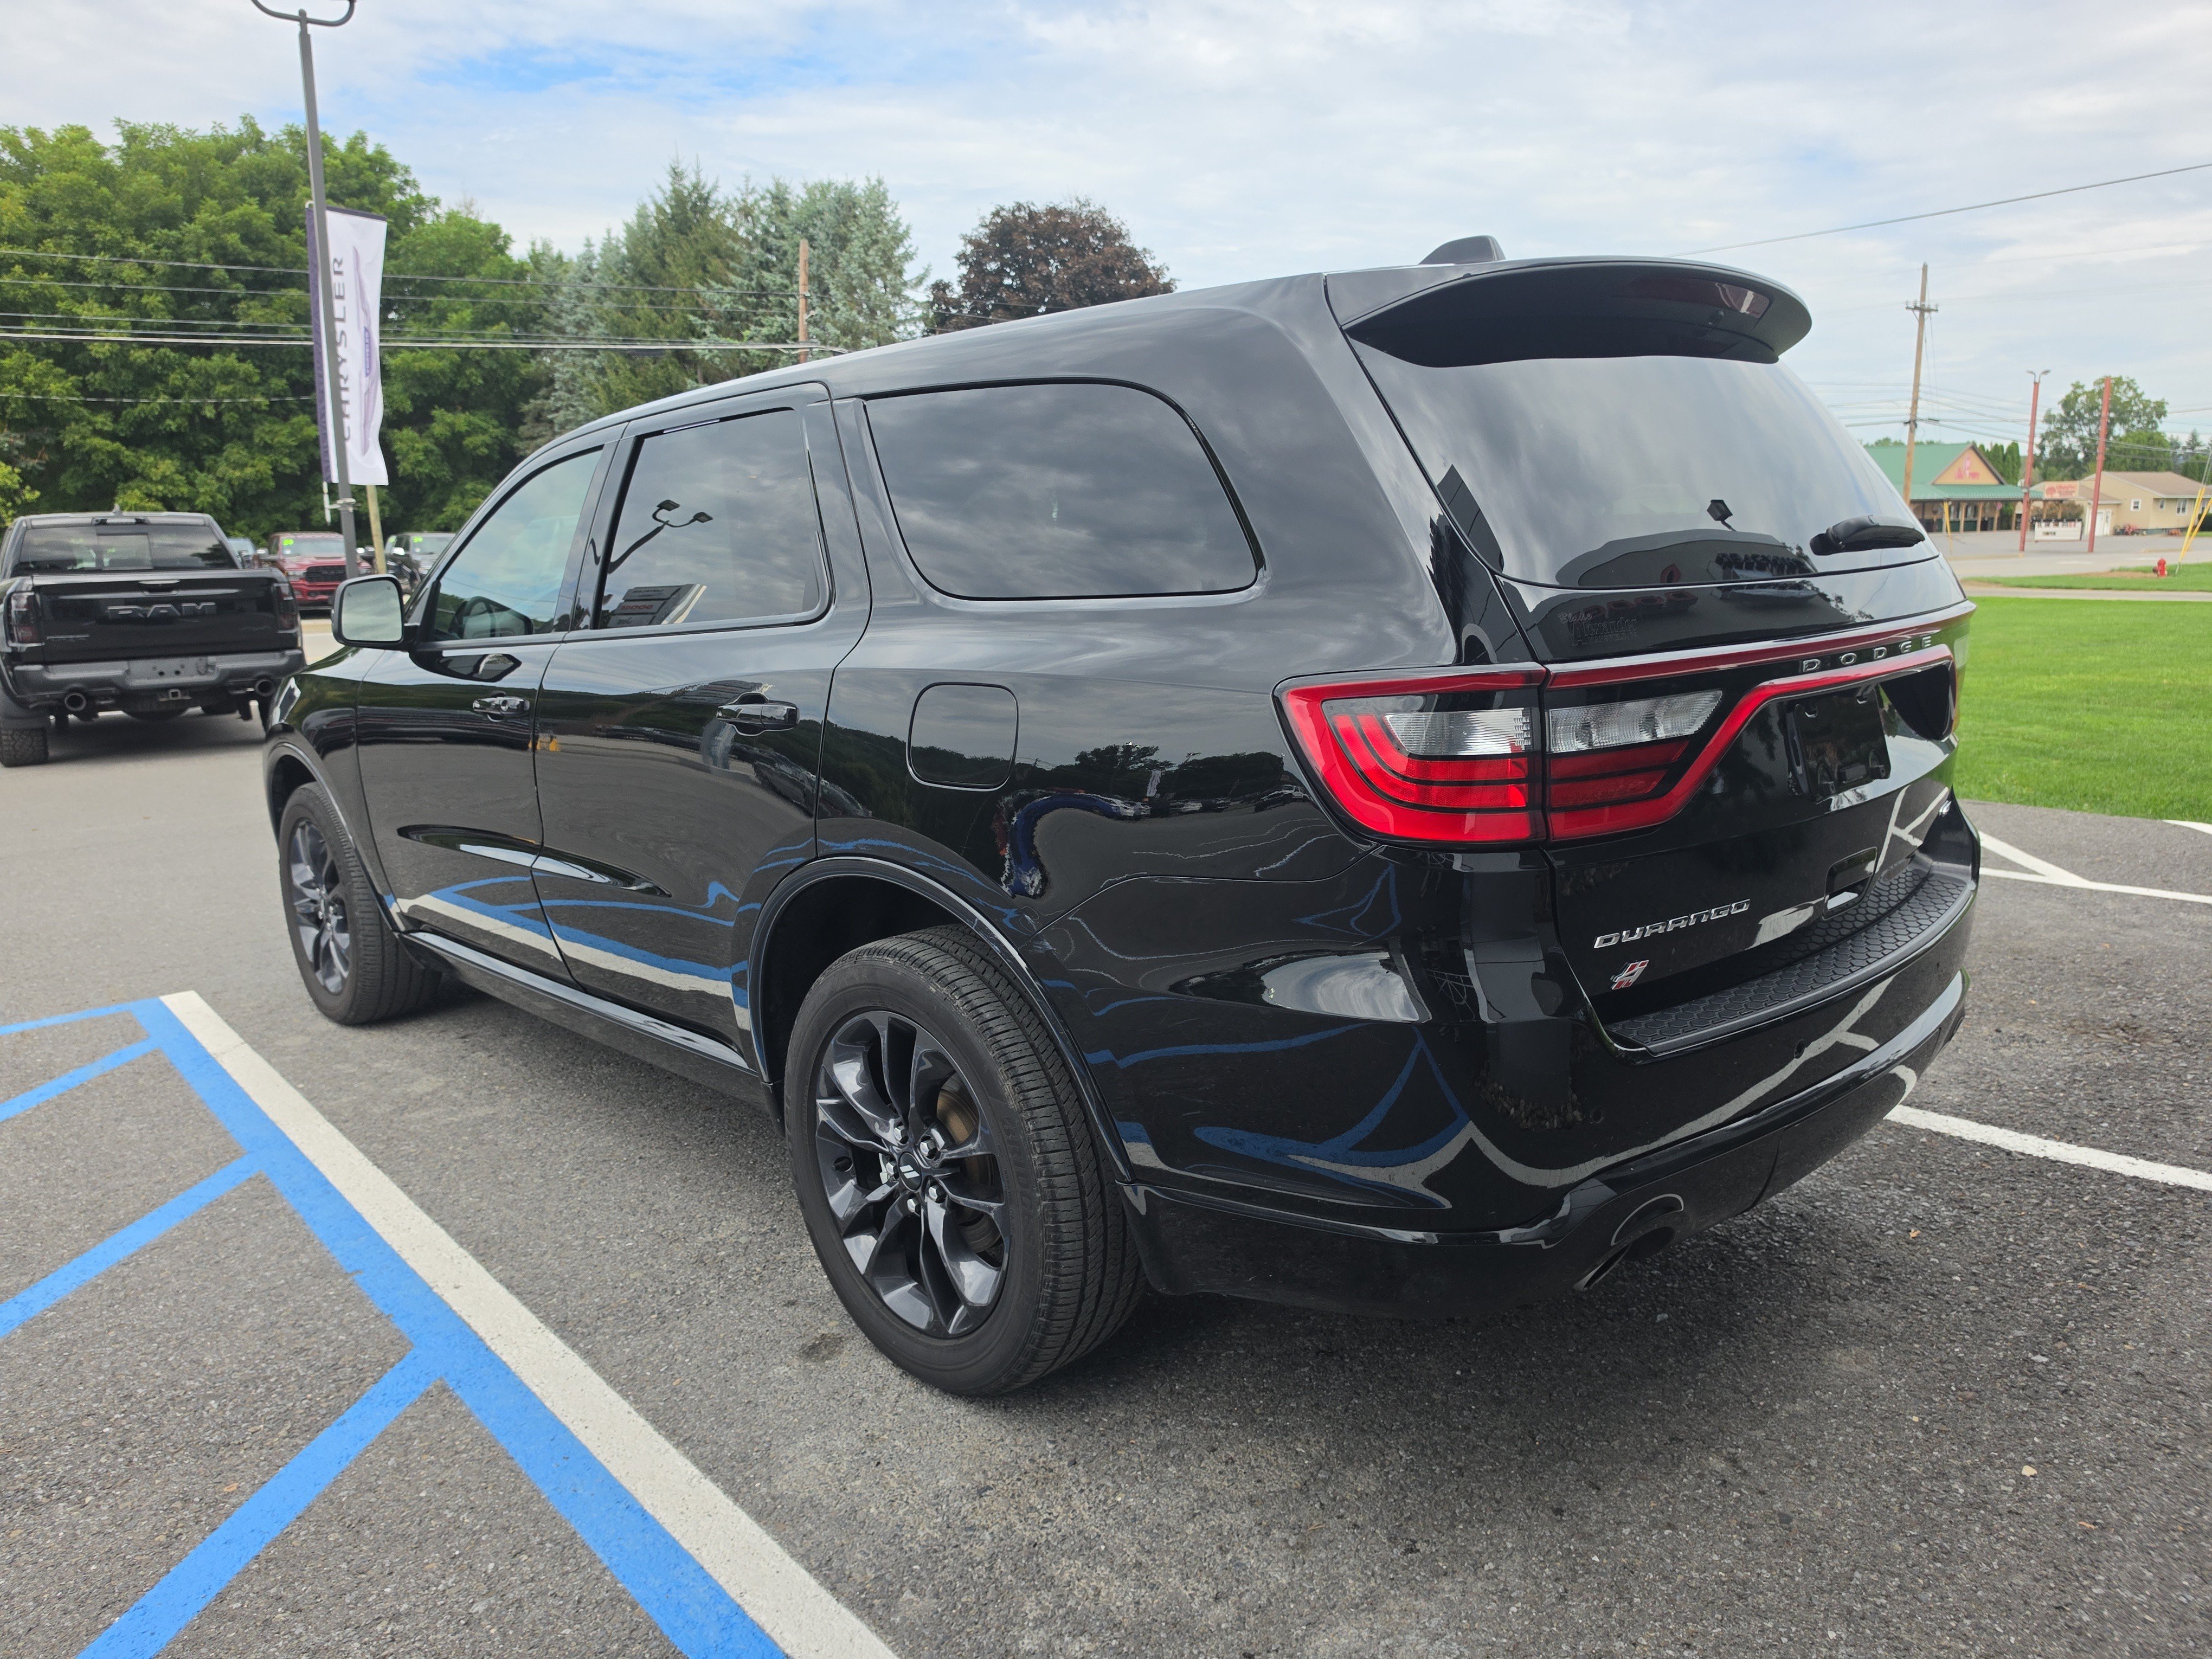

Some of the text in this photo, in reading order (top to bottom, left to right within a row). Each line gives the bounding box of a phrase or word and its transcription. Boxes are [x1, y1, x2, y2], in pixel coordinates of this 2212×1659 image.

[332, 258, 351, 443] CHRYSLER
[107, 602, 216, 619] RAM
[1572, 616, 1637, 646] Alexander
[1801, 635, 1931, 672] DODGE
[1594, 898, 1751, 949] DURANGO
